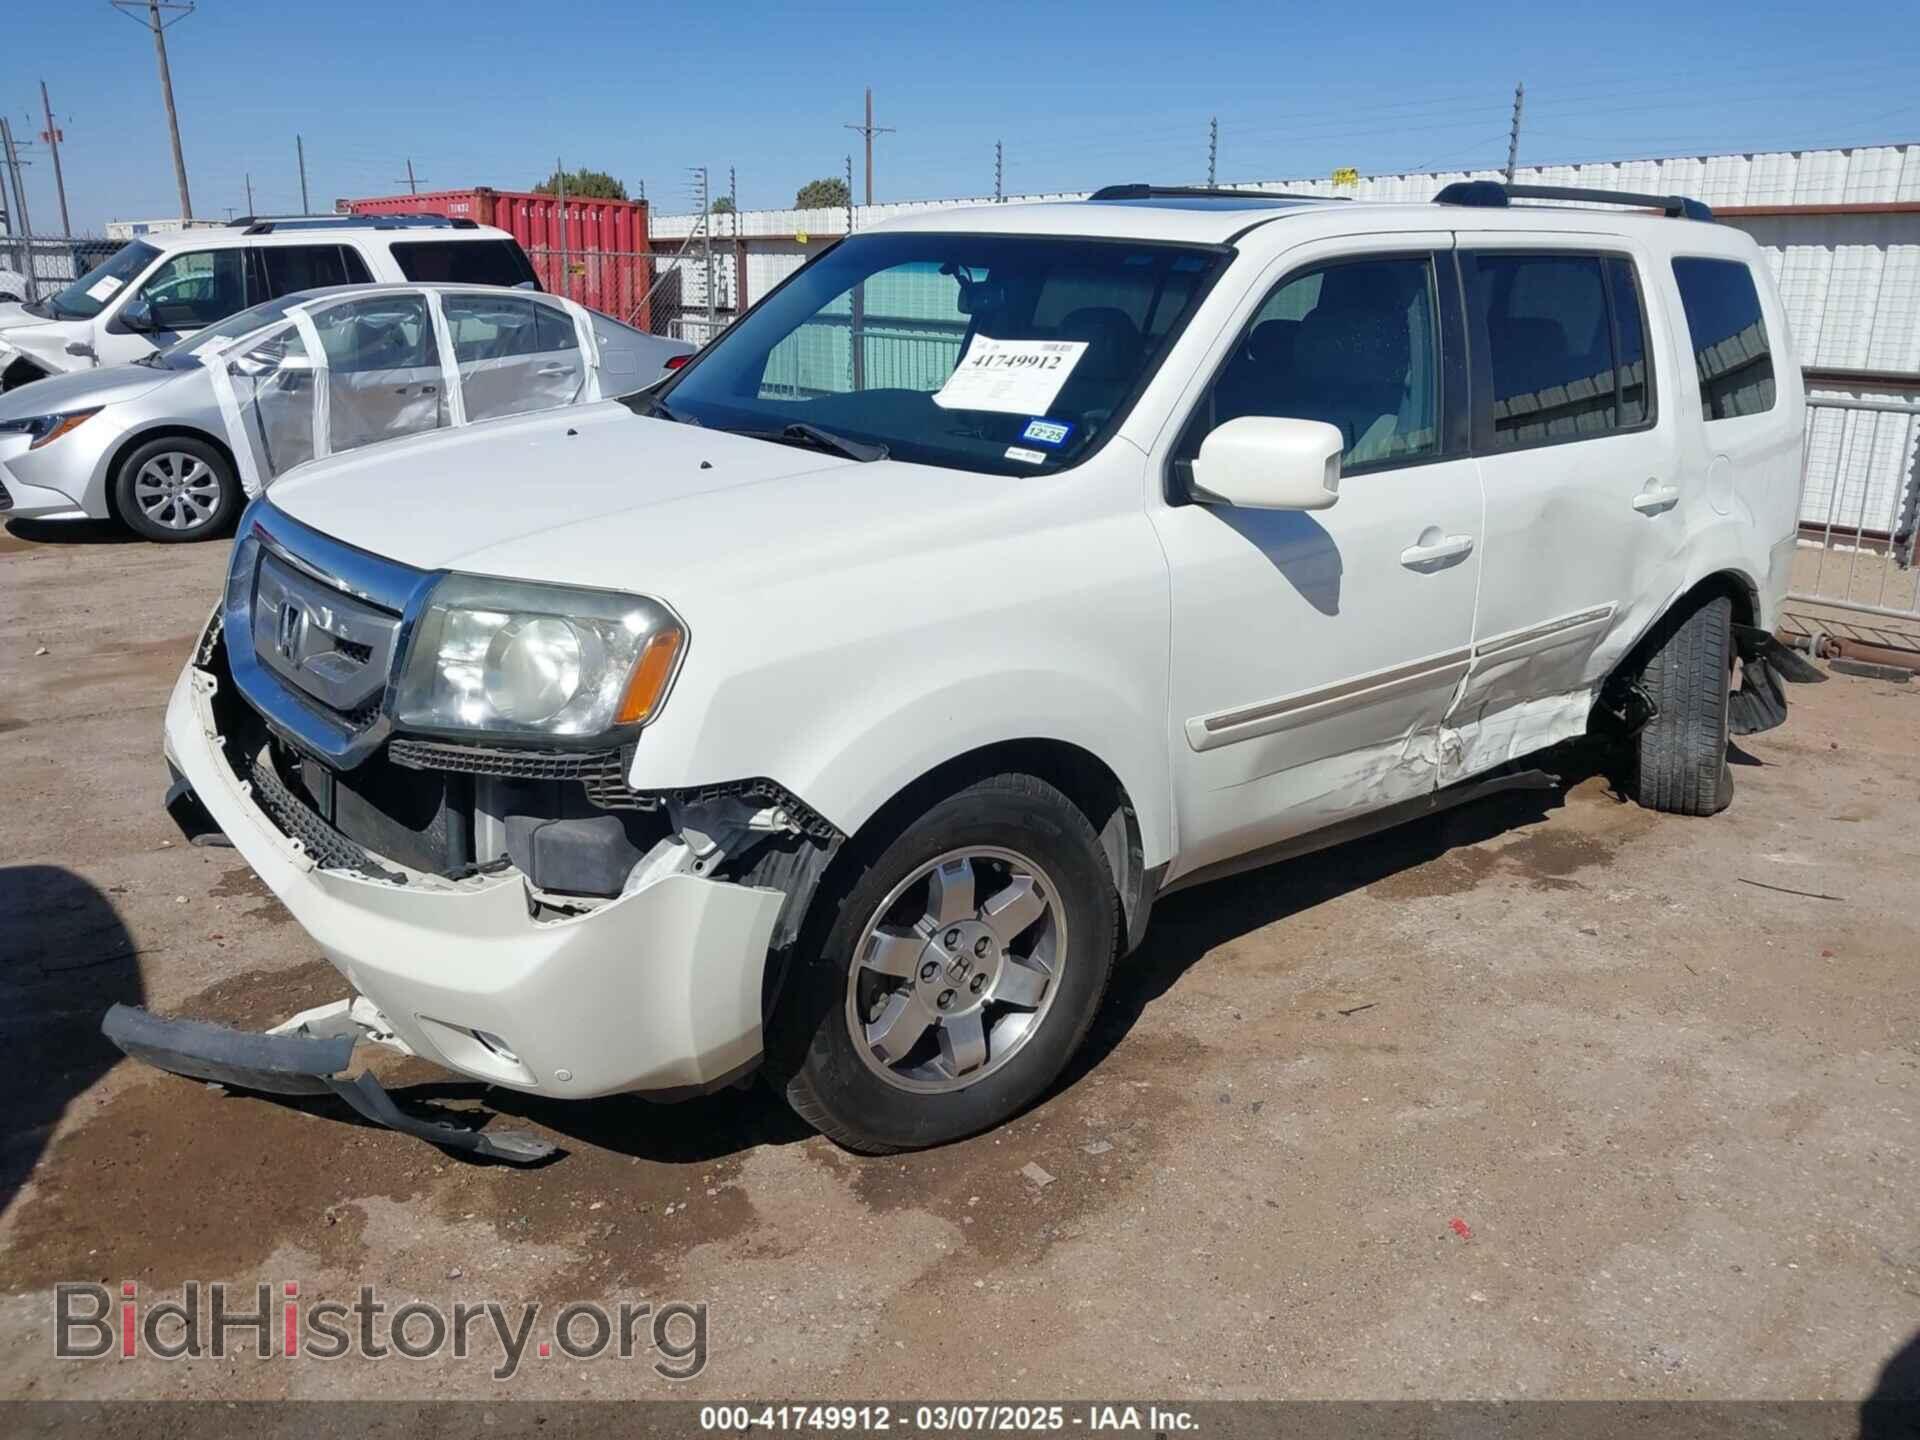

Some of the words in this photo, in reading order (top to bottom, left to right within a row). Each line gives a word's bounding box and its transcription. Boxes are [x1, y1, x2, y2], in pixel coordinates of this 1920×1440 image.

[972, 354, 1062, 369] 41749912
[1029, 427, 1044, 437] 12
[1046, 430, 1062, 441] 25
